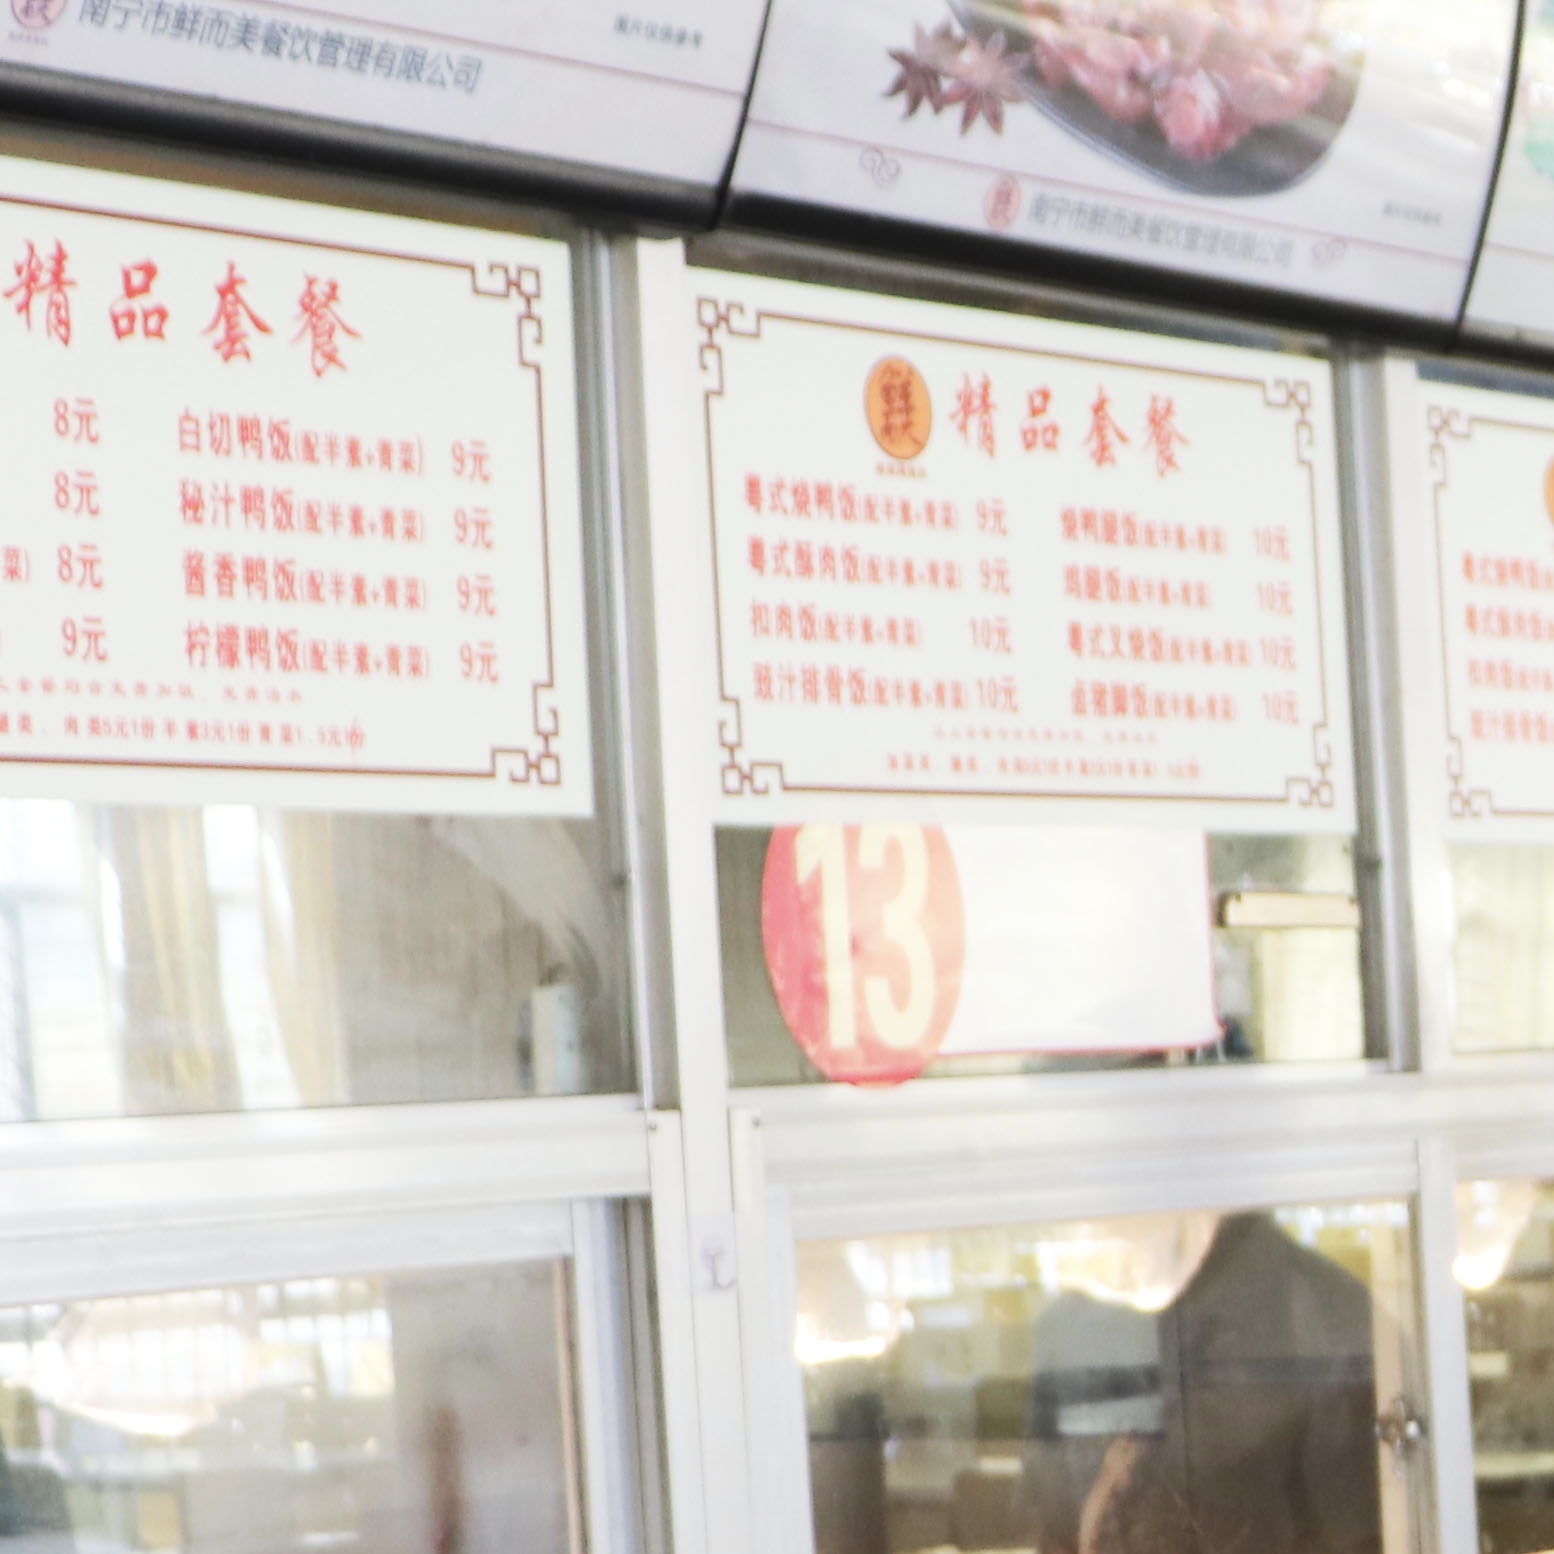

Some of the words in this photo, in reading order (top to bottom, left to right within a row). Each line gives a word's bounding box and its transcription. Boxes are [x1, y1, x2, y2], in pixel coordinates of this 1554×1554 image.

[3, 237, 361, 378] 精品套餐
[53, 397, 100, 445] 8元
[949, 371, 1190, 477] 精品套餐
[451, 439, 491, 484] 9元
[54, 470, 101, 518] 8元
[454, 507, 494, 550] 9元
[975, 498, 1009, 538] 9元
[58, 543, 103, 591] 8元
[978, 556, 1012, 597] 9元
[456, 575, 497, 619] 9元
[61, 615, 108, 664] 9元
[969, 614, 1012, 655] 10元
[459, 643, 500, 687] 9元
[975, 674, 1019, 714] 10元
[795, 824, 935, 1051] 13
